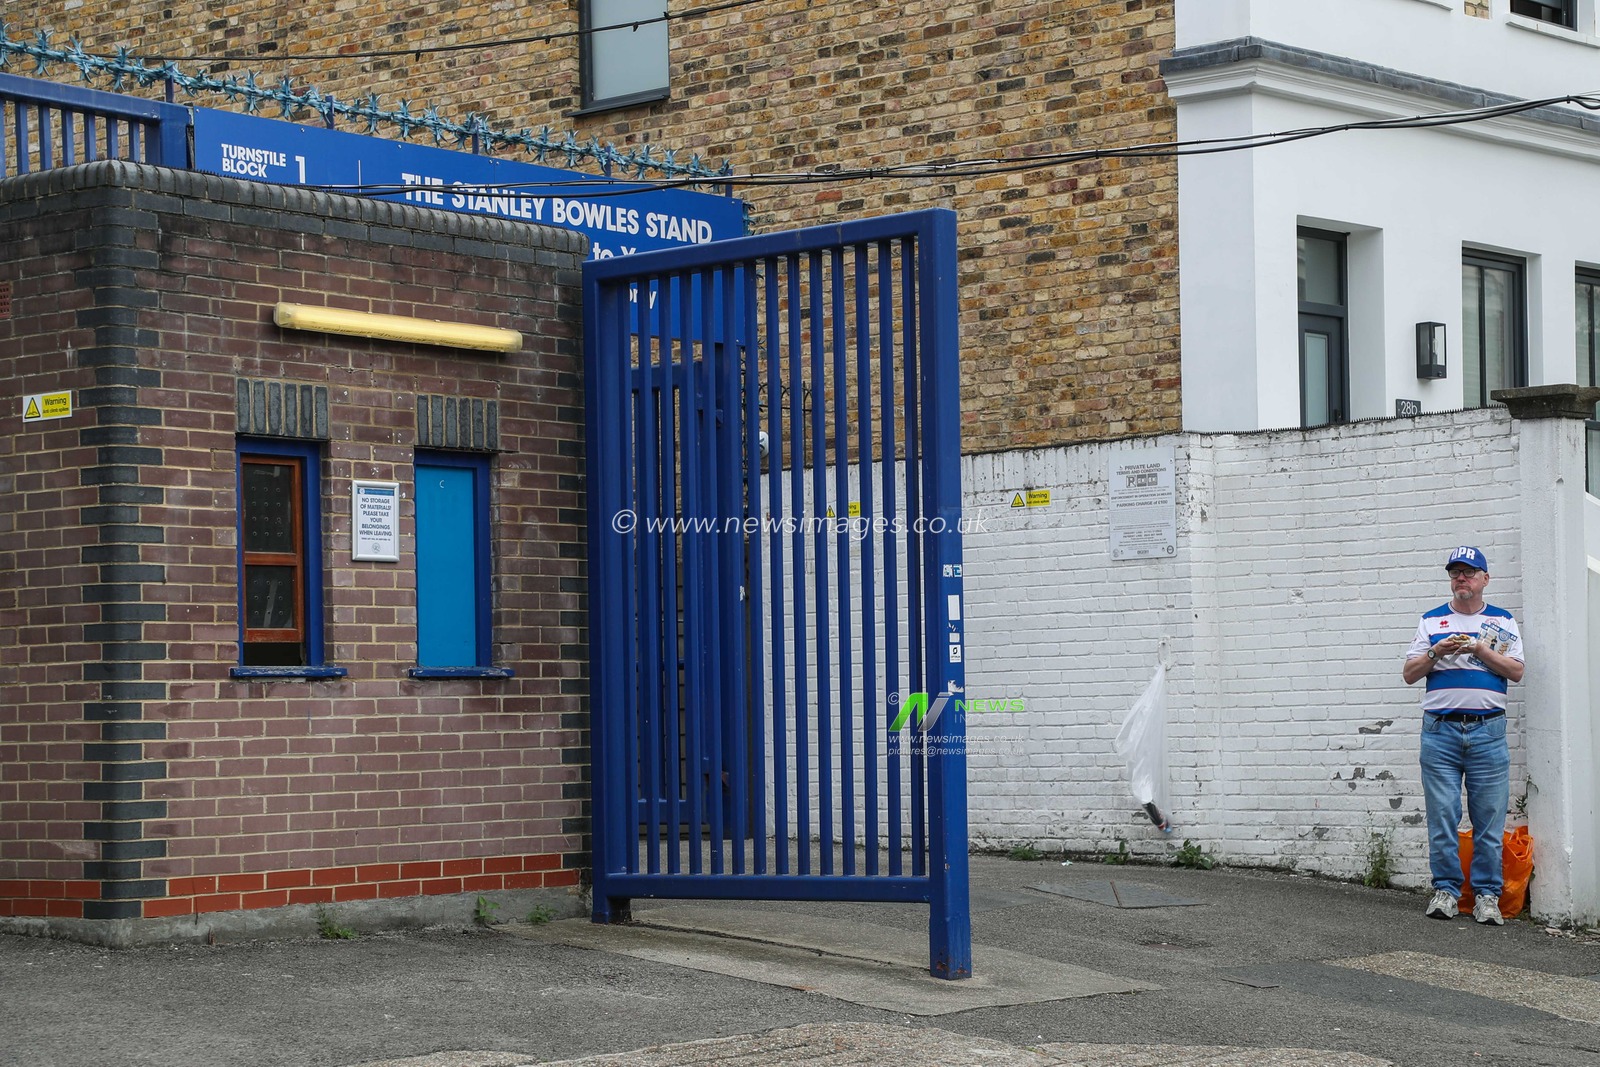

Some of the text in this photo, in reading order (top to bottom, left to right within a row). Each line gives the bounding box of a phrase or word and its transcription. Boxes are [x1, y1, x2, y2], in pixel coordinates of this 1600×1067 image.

[221, 143, 286, 167] TURNSTILE
[222, 158, 267, 178] BLOCK
[295, 156, 305, 183] 1
[402, 173, 712, 244] THE STANLEY BOWLES STAND
[44, 397, 66, 406] Warning
[1401, 401, 1417, 414] 28b
